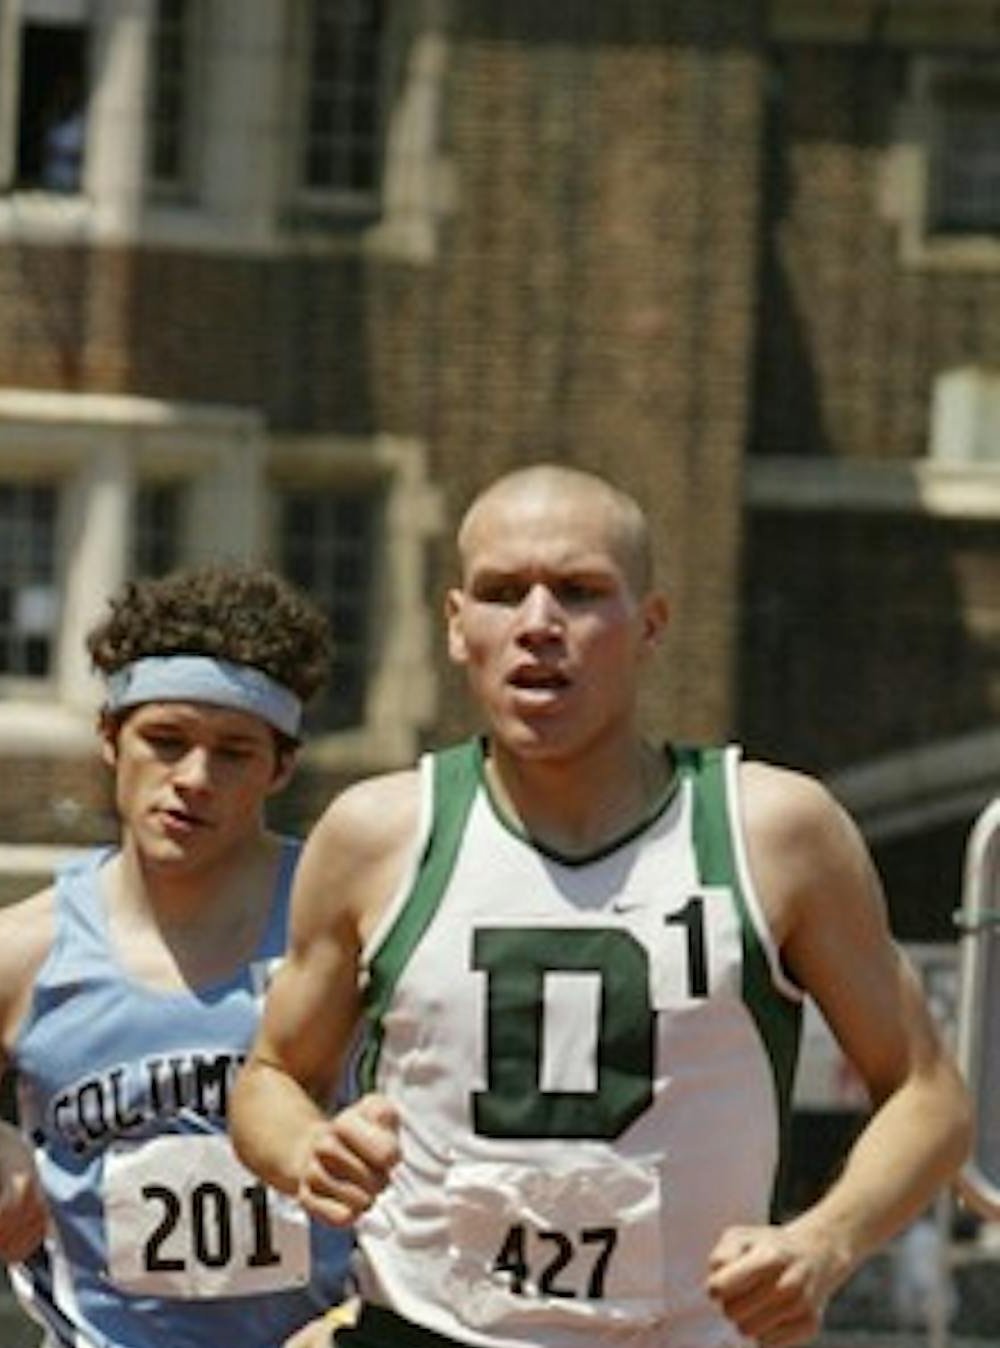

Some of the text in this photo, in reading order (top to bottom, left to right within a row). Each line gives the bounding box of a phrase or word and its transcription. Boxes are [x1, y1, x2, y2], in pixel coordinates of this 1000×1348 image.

[664, 896, 709, 998] 1
[472, 927, 657, 1140] D
[55, 1053, 244, 1153] COLUM
[142, 1182, 281, 1271] 201
[494, 1224, 618, 1299] 427
